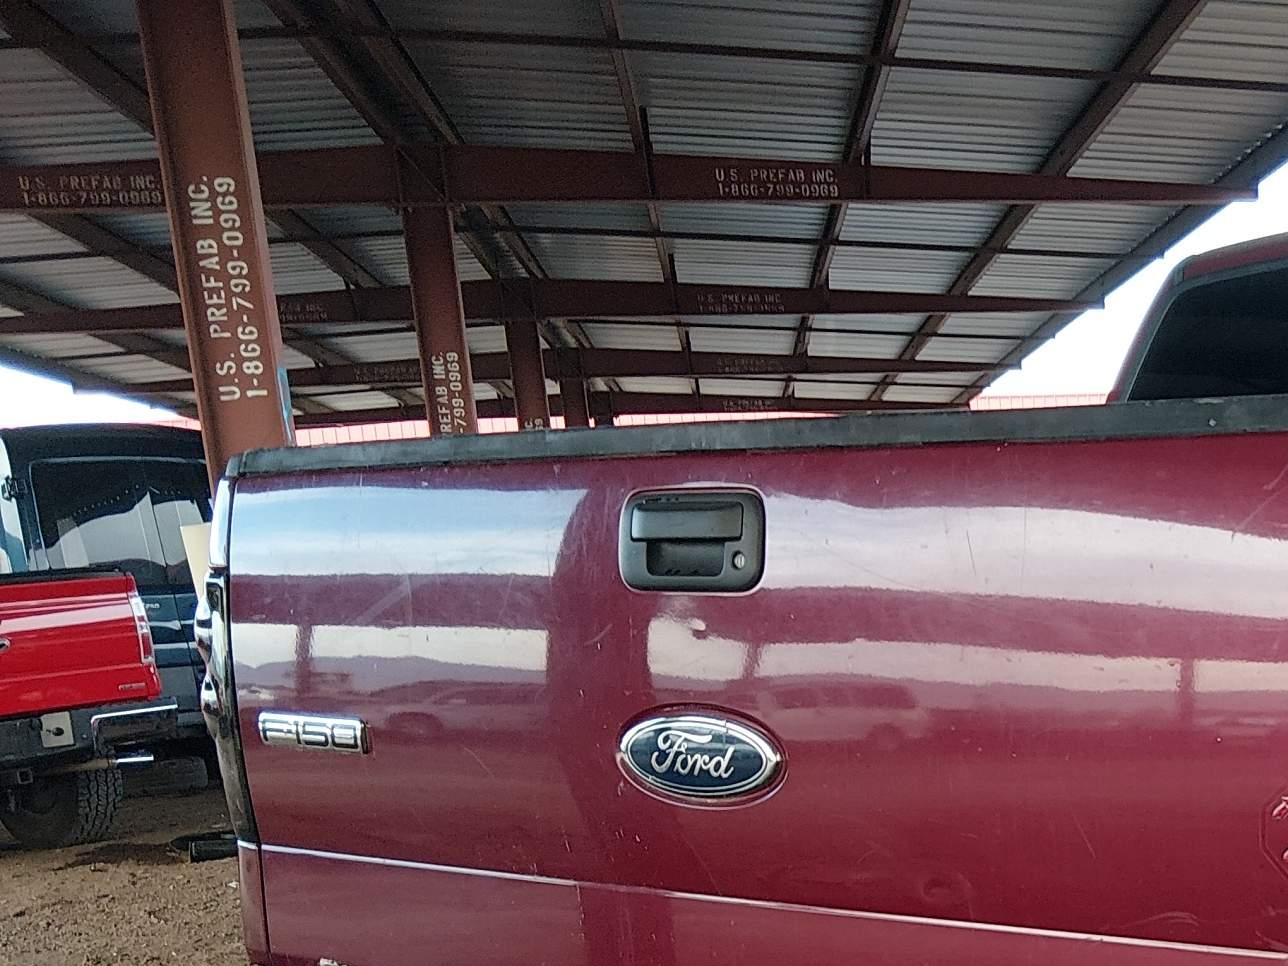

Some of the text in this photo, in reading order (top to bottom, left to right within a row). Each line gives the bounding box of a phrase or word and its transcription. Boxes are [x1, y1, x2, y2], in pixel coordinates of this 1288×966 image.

[59, 175, 122, 190] PREFAB
[129, 175, 161, 190] INC.
[719, 183, 839, 197] 1-866-799-0969
[750, 168, 805, 182] PREFAB
[811, 169, 838, 183] INC.
[188, 175, 242, 401] U.S. PREFAB INC.
[214, 176, 269, 398] 1-866-799-0969
[435, 386, 453, 434] REFAB
[651, 730, 736, 778] Ford
